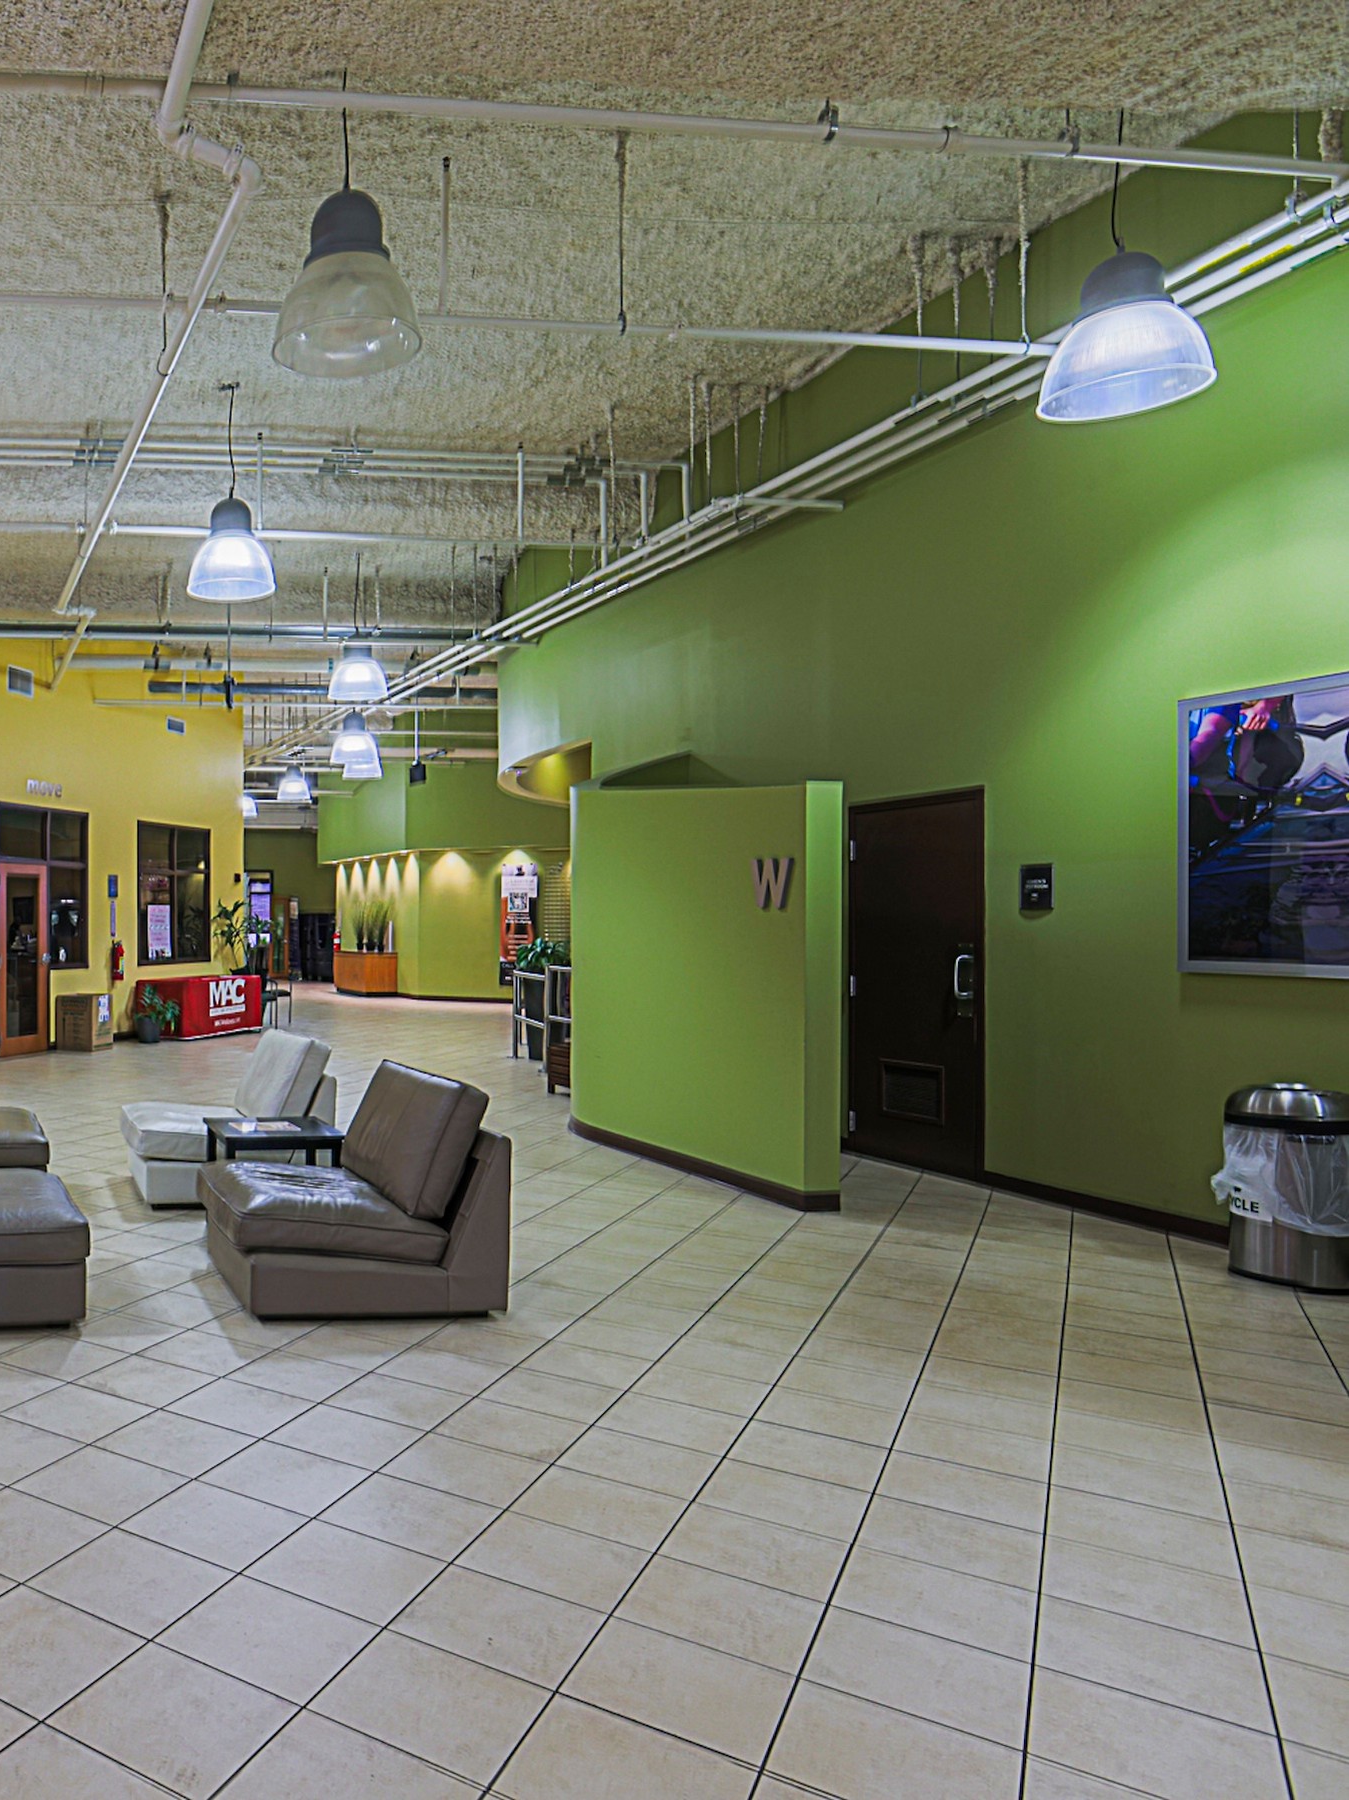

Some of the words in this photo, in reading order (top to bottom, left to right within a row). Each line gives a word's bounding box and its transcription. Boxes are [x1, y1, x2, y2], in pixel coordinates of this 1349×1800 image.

[26, 778, 63, 798] move
[751, 857, 795, 911] W
[209, 978, 246, 1008] MAC
